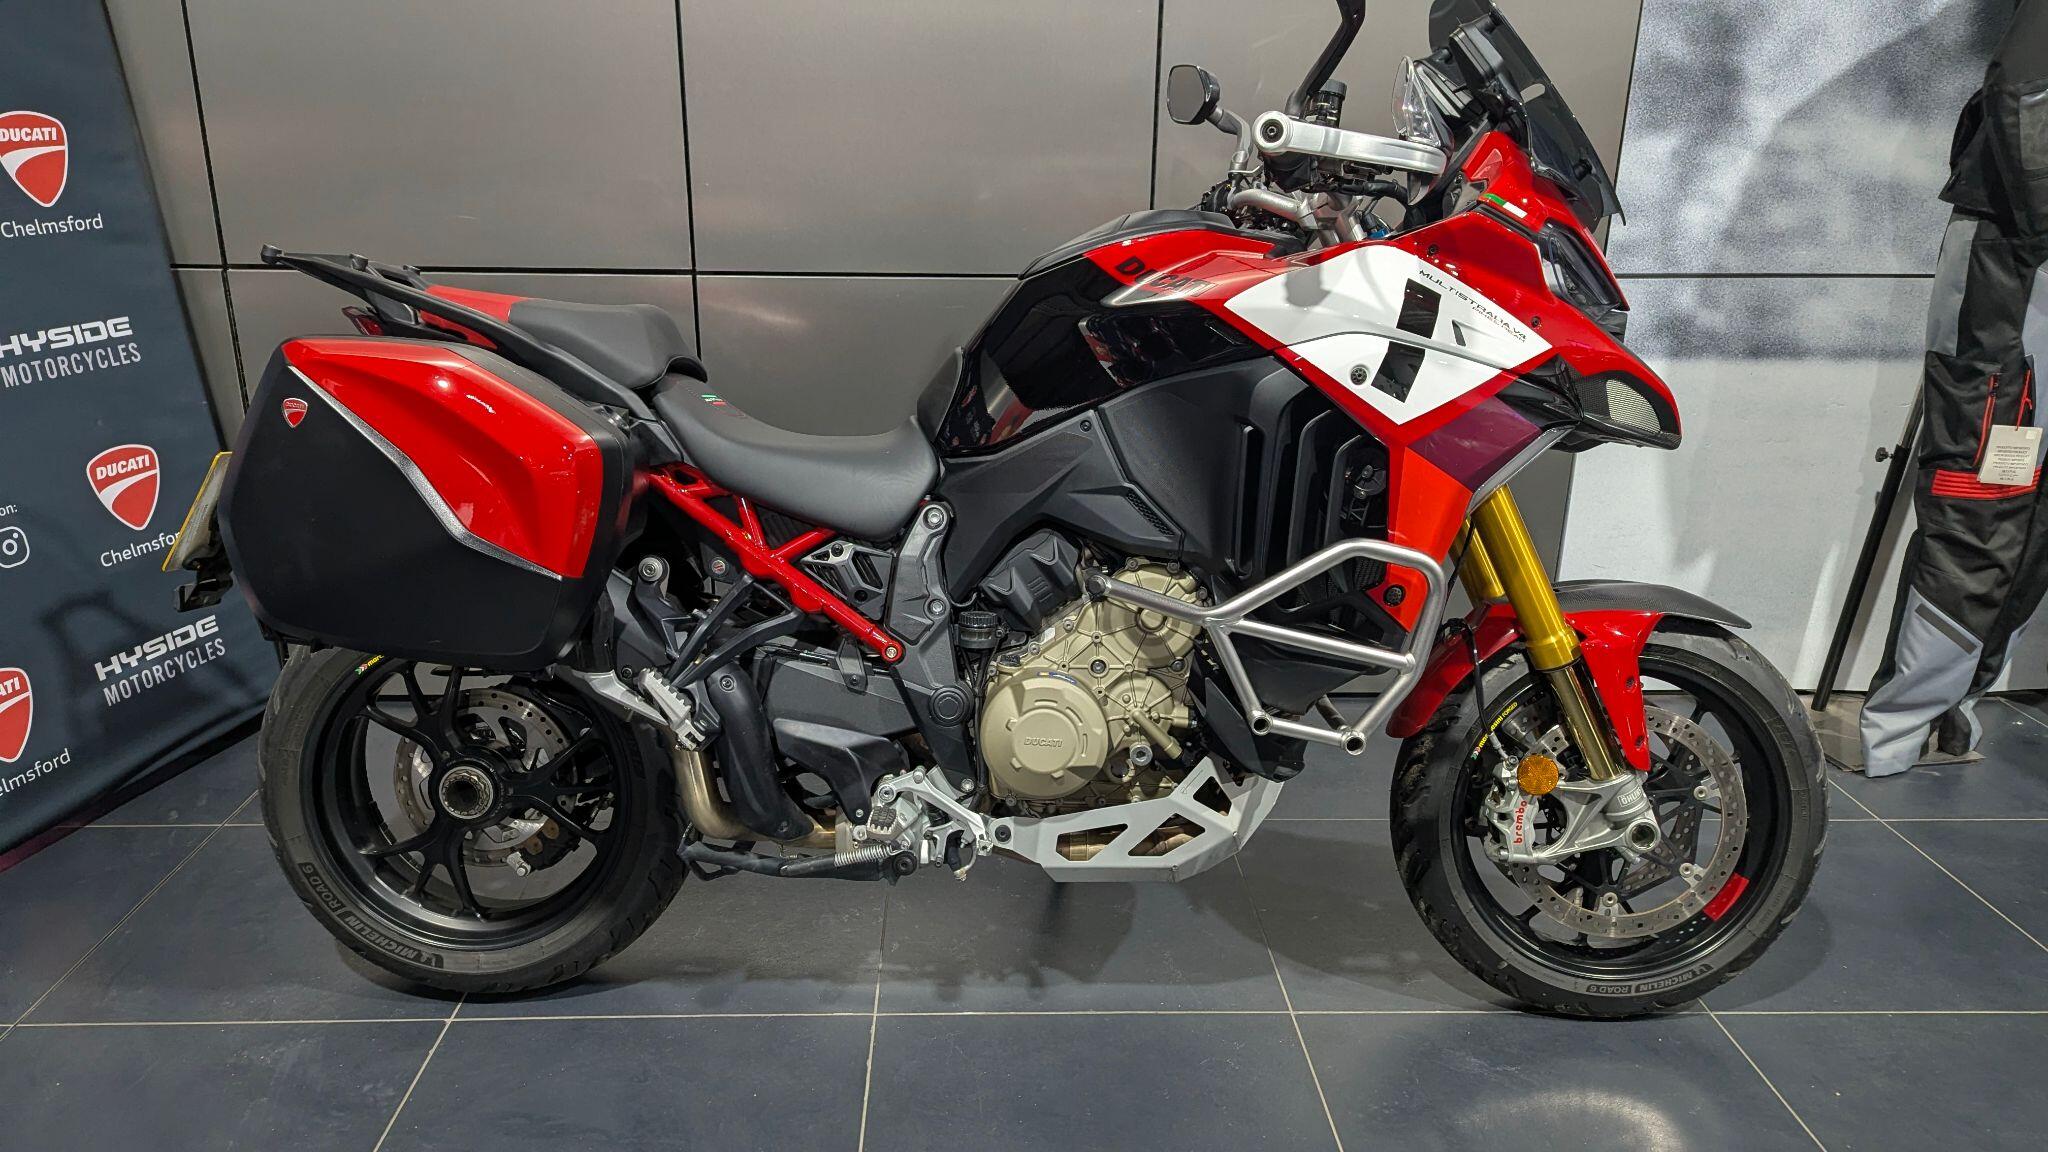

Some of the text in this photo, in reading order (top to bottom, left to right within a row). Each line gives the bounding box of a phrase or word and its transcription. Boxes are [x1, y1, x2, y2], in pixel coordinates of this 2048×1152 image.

[0, 127, 57, 141] DUCATI
[1, 213, 103, 238] Chelmsford
[0, 316, 133, 358] HYSIDE
[0, 342, 141, 388] MOTORCYCLES
[96, 454, 150, 480] DUCATI
[101, 532, 180, 567] Chelmsfor
[94, 615, 219, 682] HYSIDE
[103, 639, 226, 707] MOTORCYCLES
[1023, 736, 1063, 748] DUCATI
[1513, 800, 1528, 844] brembo
[309, 876, 341, 911] ROAD
[345, 914, 418, 960] MICHELIN
[1599, 985, 1629, 994] ROAD
[1639, 971, 1693, 992] MICHELIN
